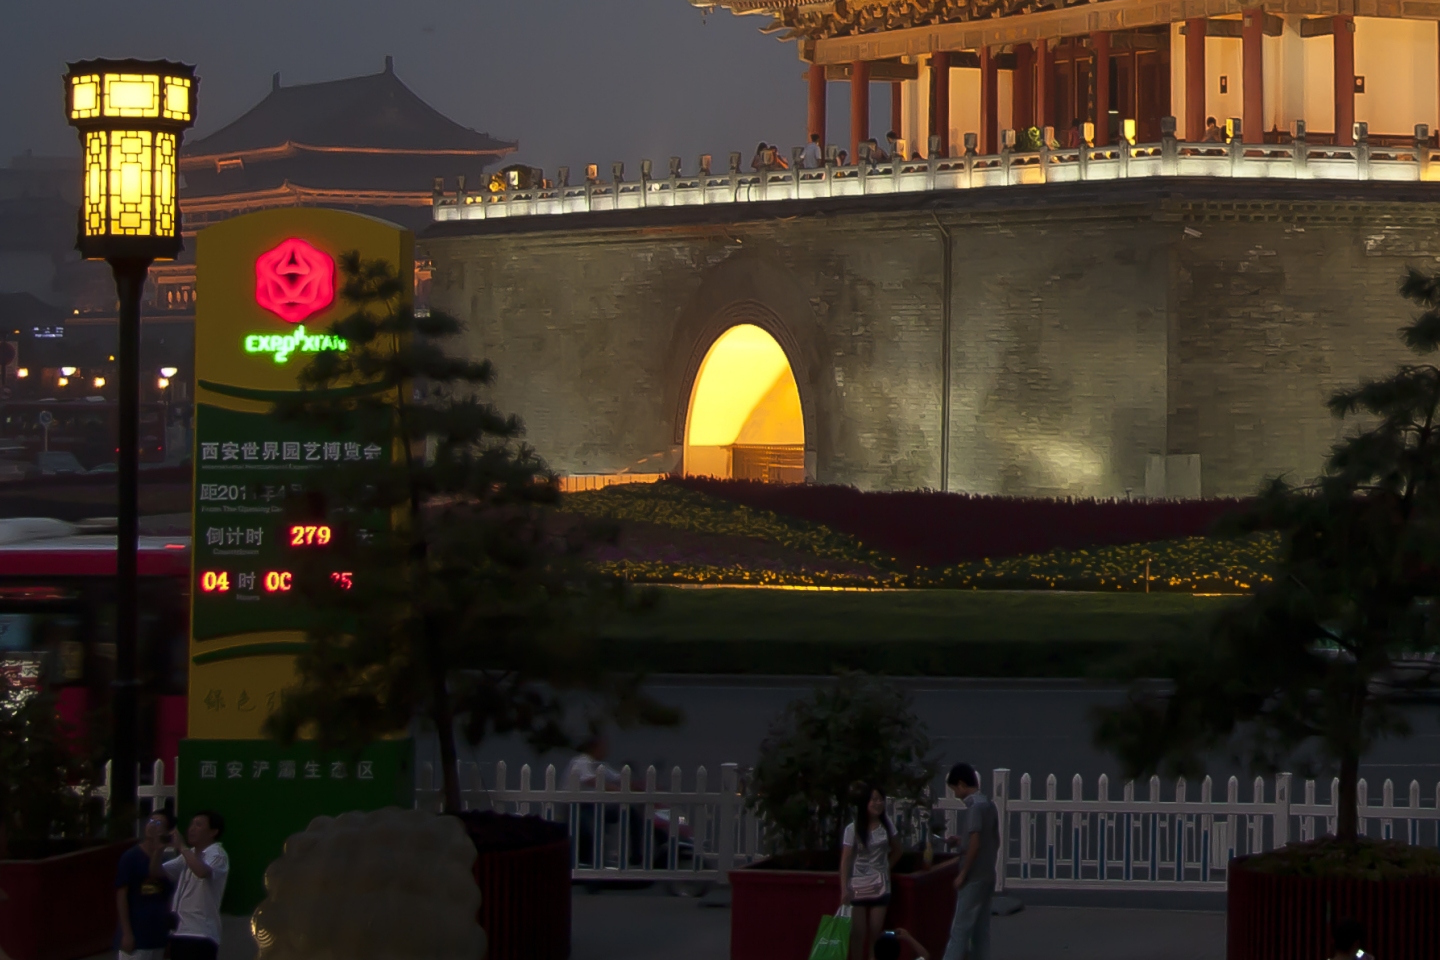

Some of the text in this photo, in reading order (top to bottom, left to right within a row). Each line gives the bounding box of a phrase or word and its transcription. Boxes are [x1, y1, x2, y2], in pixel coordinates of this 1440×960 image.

[201, 441, 382, 461] 西安世界园艺博览会
[206, 526, 264, 546] 倒计时
[290, 526, 332, 546] 279
[202, 571, 230, 591] 04
[238, 571, 256, 590] 时
[200, 760, 374, 780] 西安浐灞生态区
